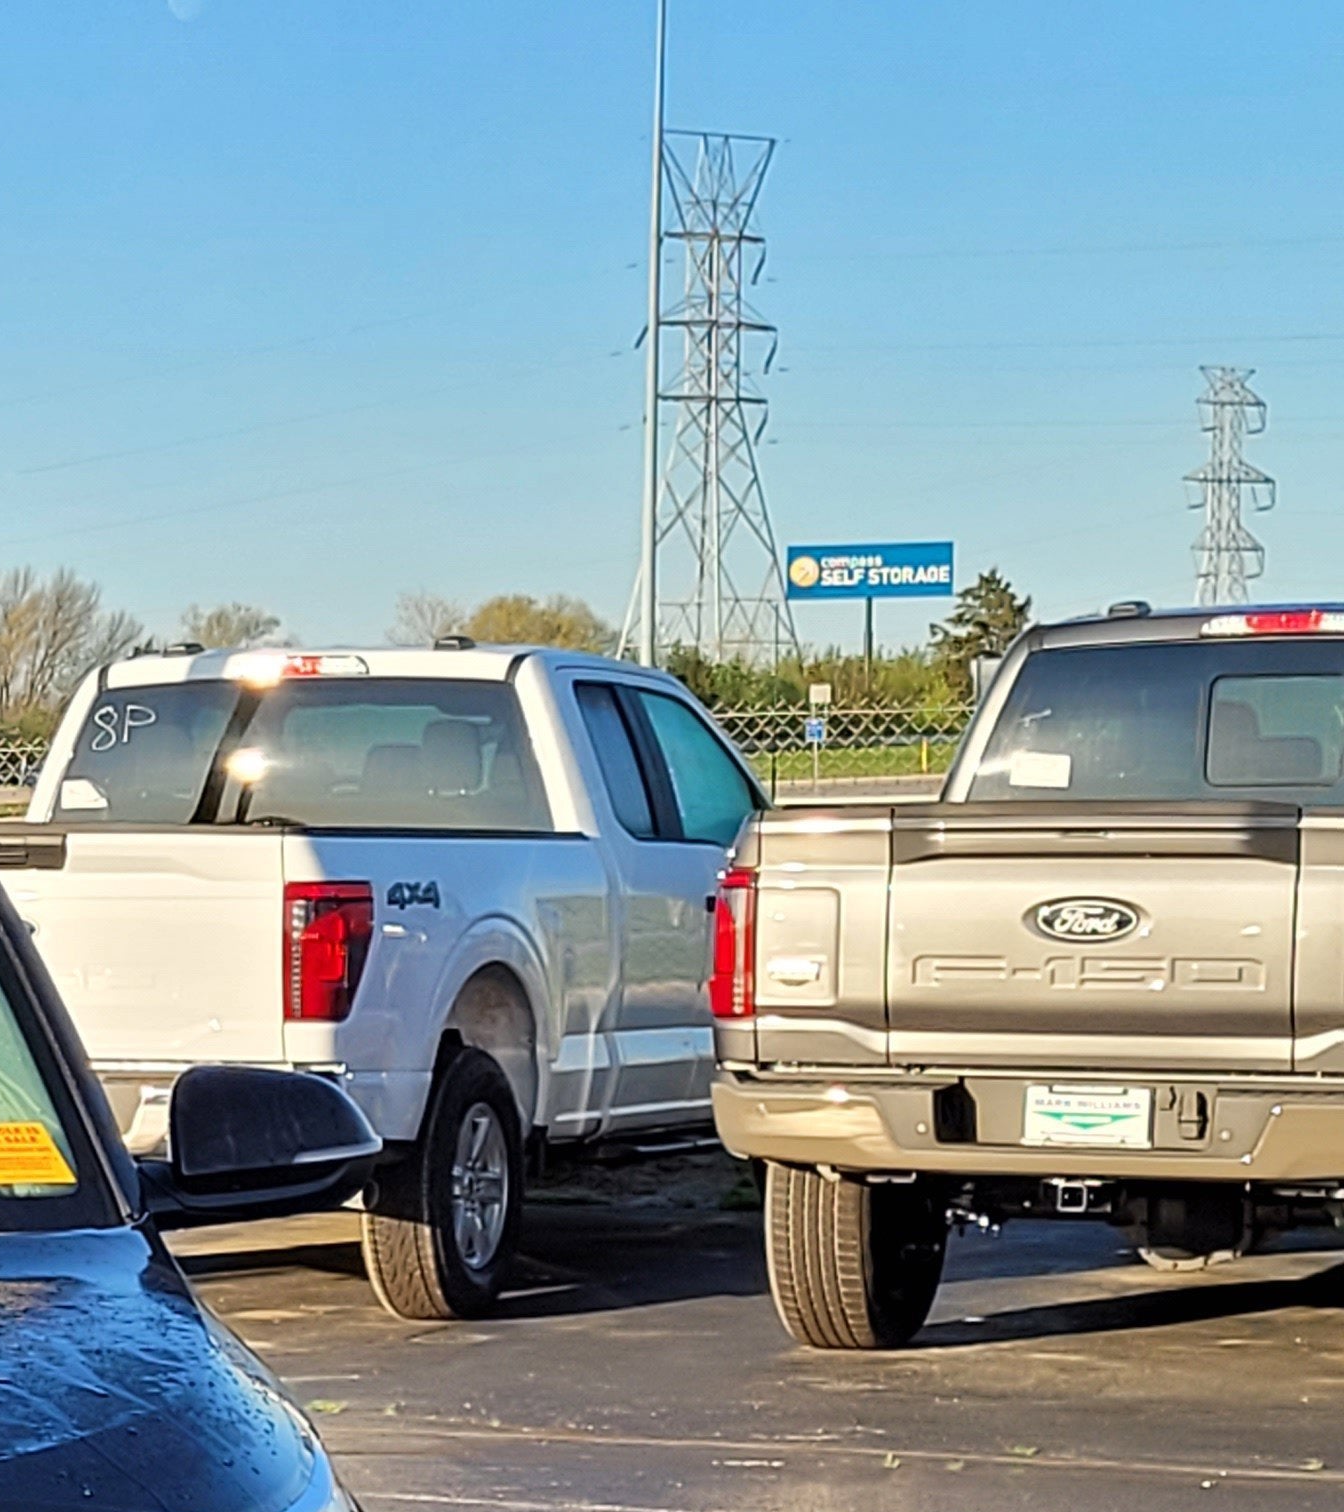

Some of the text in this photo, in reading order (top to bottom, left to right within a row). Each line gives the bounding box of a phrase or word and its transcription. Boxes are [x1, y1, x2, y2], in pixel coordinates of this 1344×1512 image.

[820, 565, 950, 587] SELF STORAGE
[92, 704, 156, 750] 8P
[1054, 906, 1120, 934] Ford
[911, 954, 1266, 991] F-150
